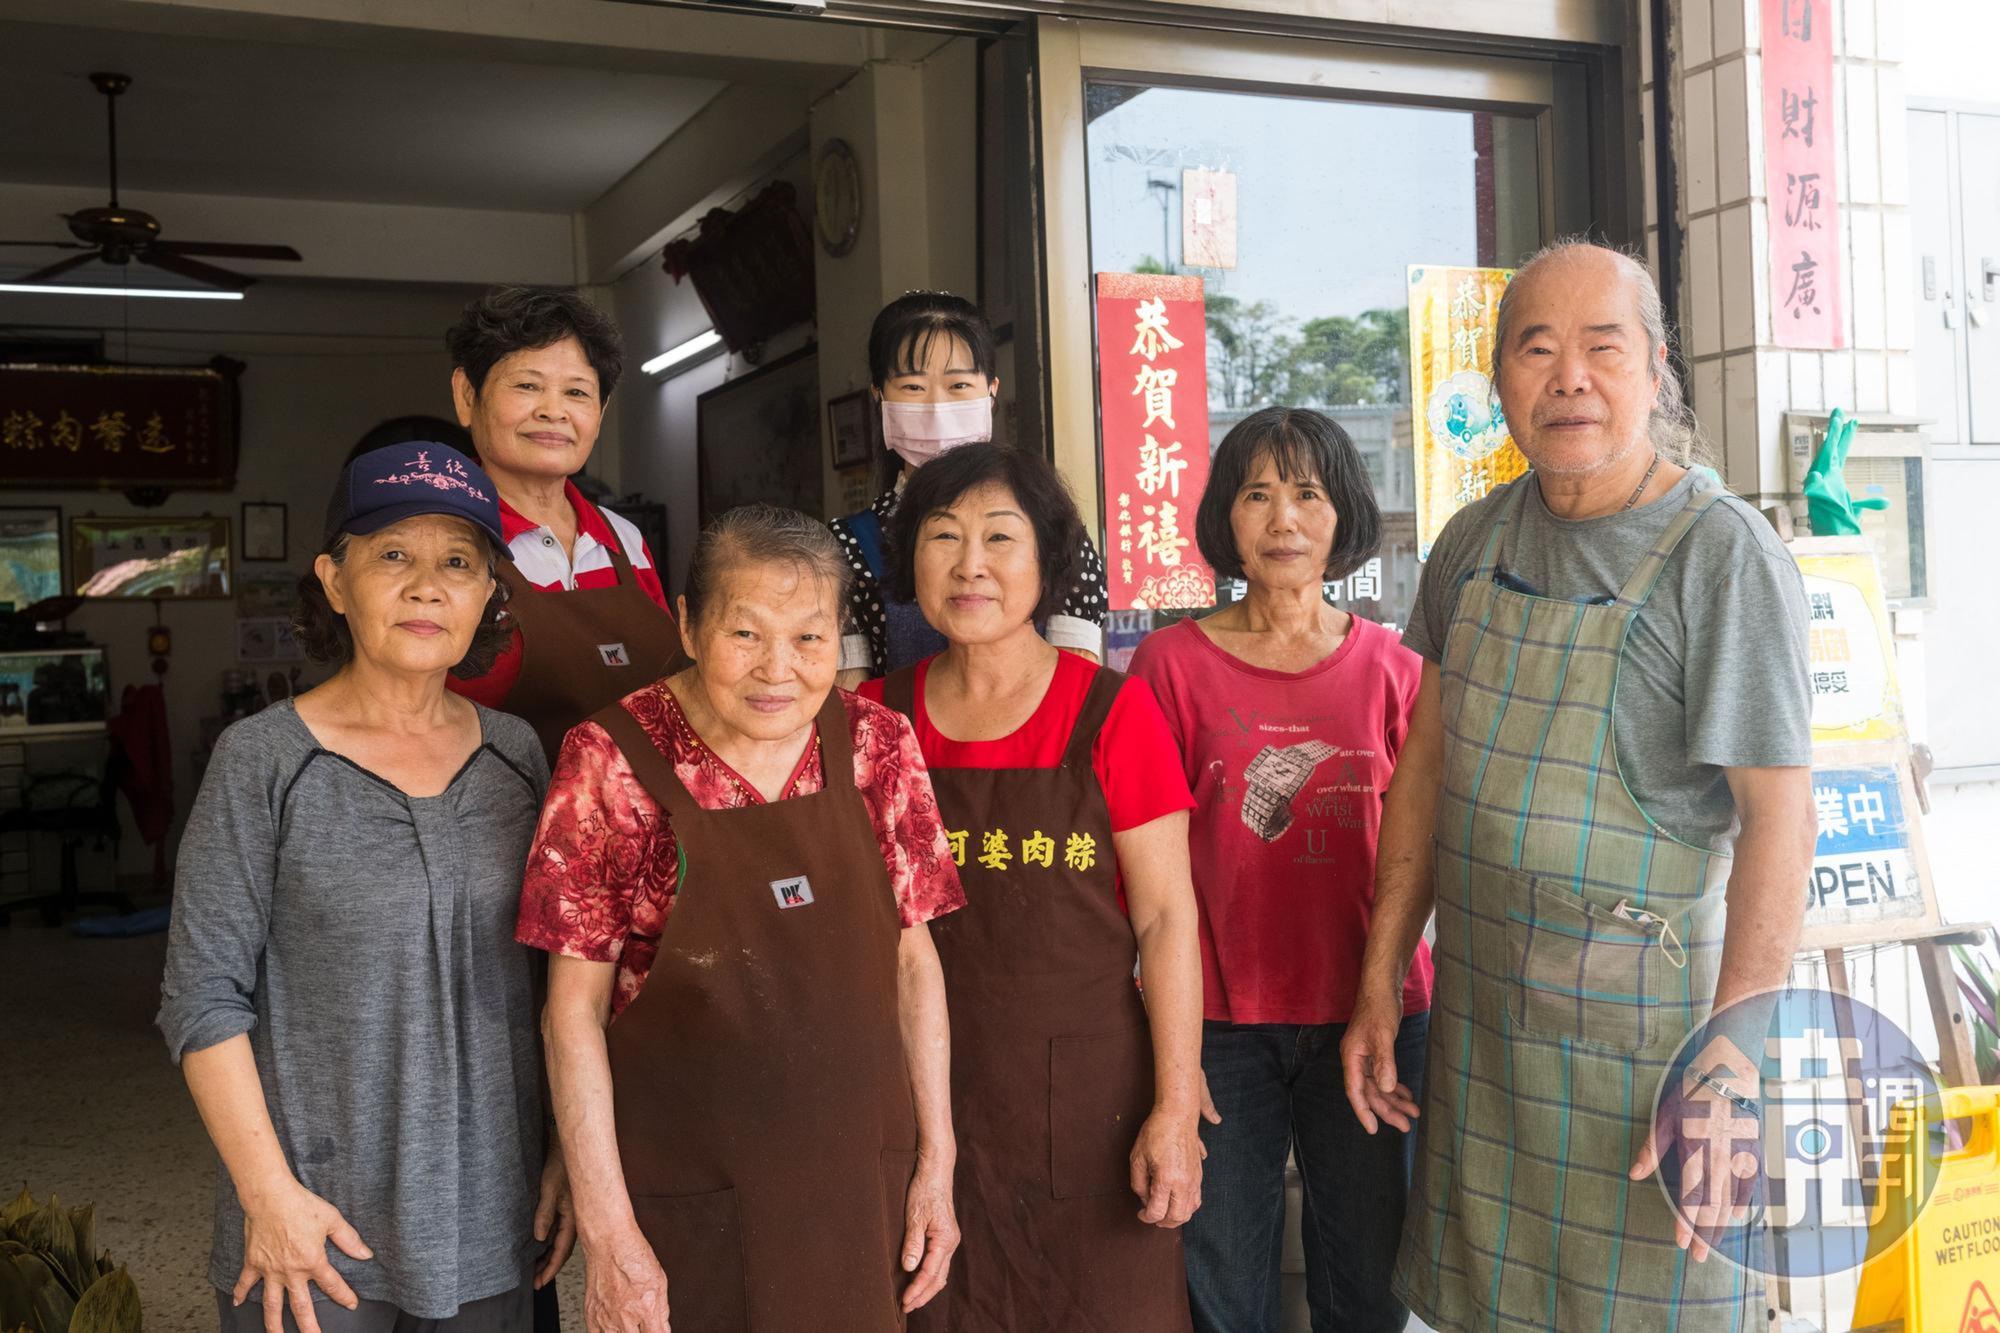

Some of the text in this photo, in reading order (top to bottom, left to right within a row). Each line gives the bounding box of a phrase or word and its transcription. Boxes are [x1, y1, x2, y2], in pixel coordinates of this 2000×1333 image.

[1129, 295, 1190, 567] 恭賀新禧
[1809, 671, 1850, 695] 停受
[1258, 723, 1310, 734] sizes-that
[1356, 750, 1376, 758] over
[1316, 785, 1339, 795] over
[1339, 782, 1362, 794] what
[1305, 801, 1353, 819] Wrist
[1303, 828, 1330, 855] U
[1935, 1245, 1964, 1266] WET
